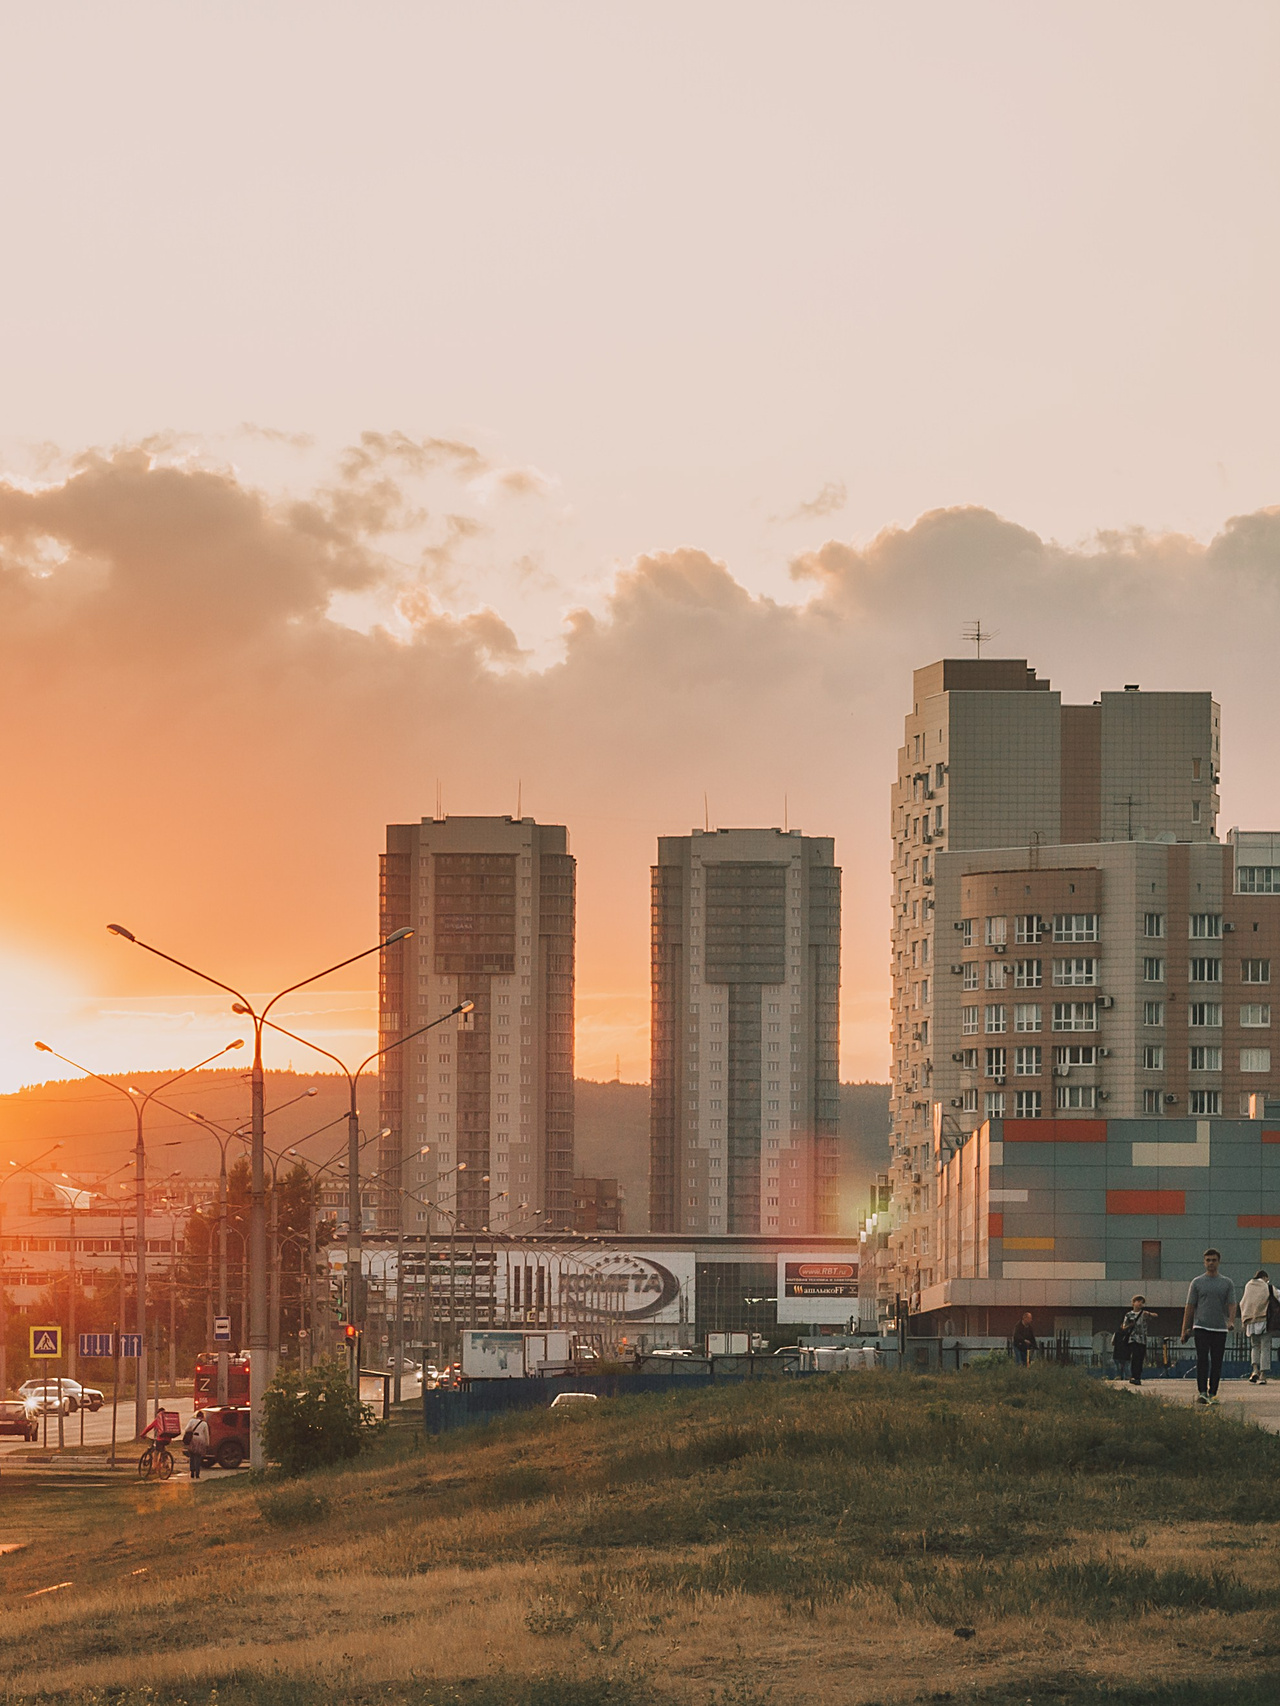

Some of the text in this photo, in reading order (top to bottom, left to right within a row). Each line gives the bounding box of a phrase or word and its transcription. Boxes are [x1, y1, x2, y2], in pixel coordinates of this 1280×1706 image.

[802, 1267, 847, 1275] www.RBT.ru
[559, 1273, 663, 1293] КОМЕТА
[200, 1378, 211, 1392] Z
